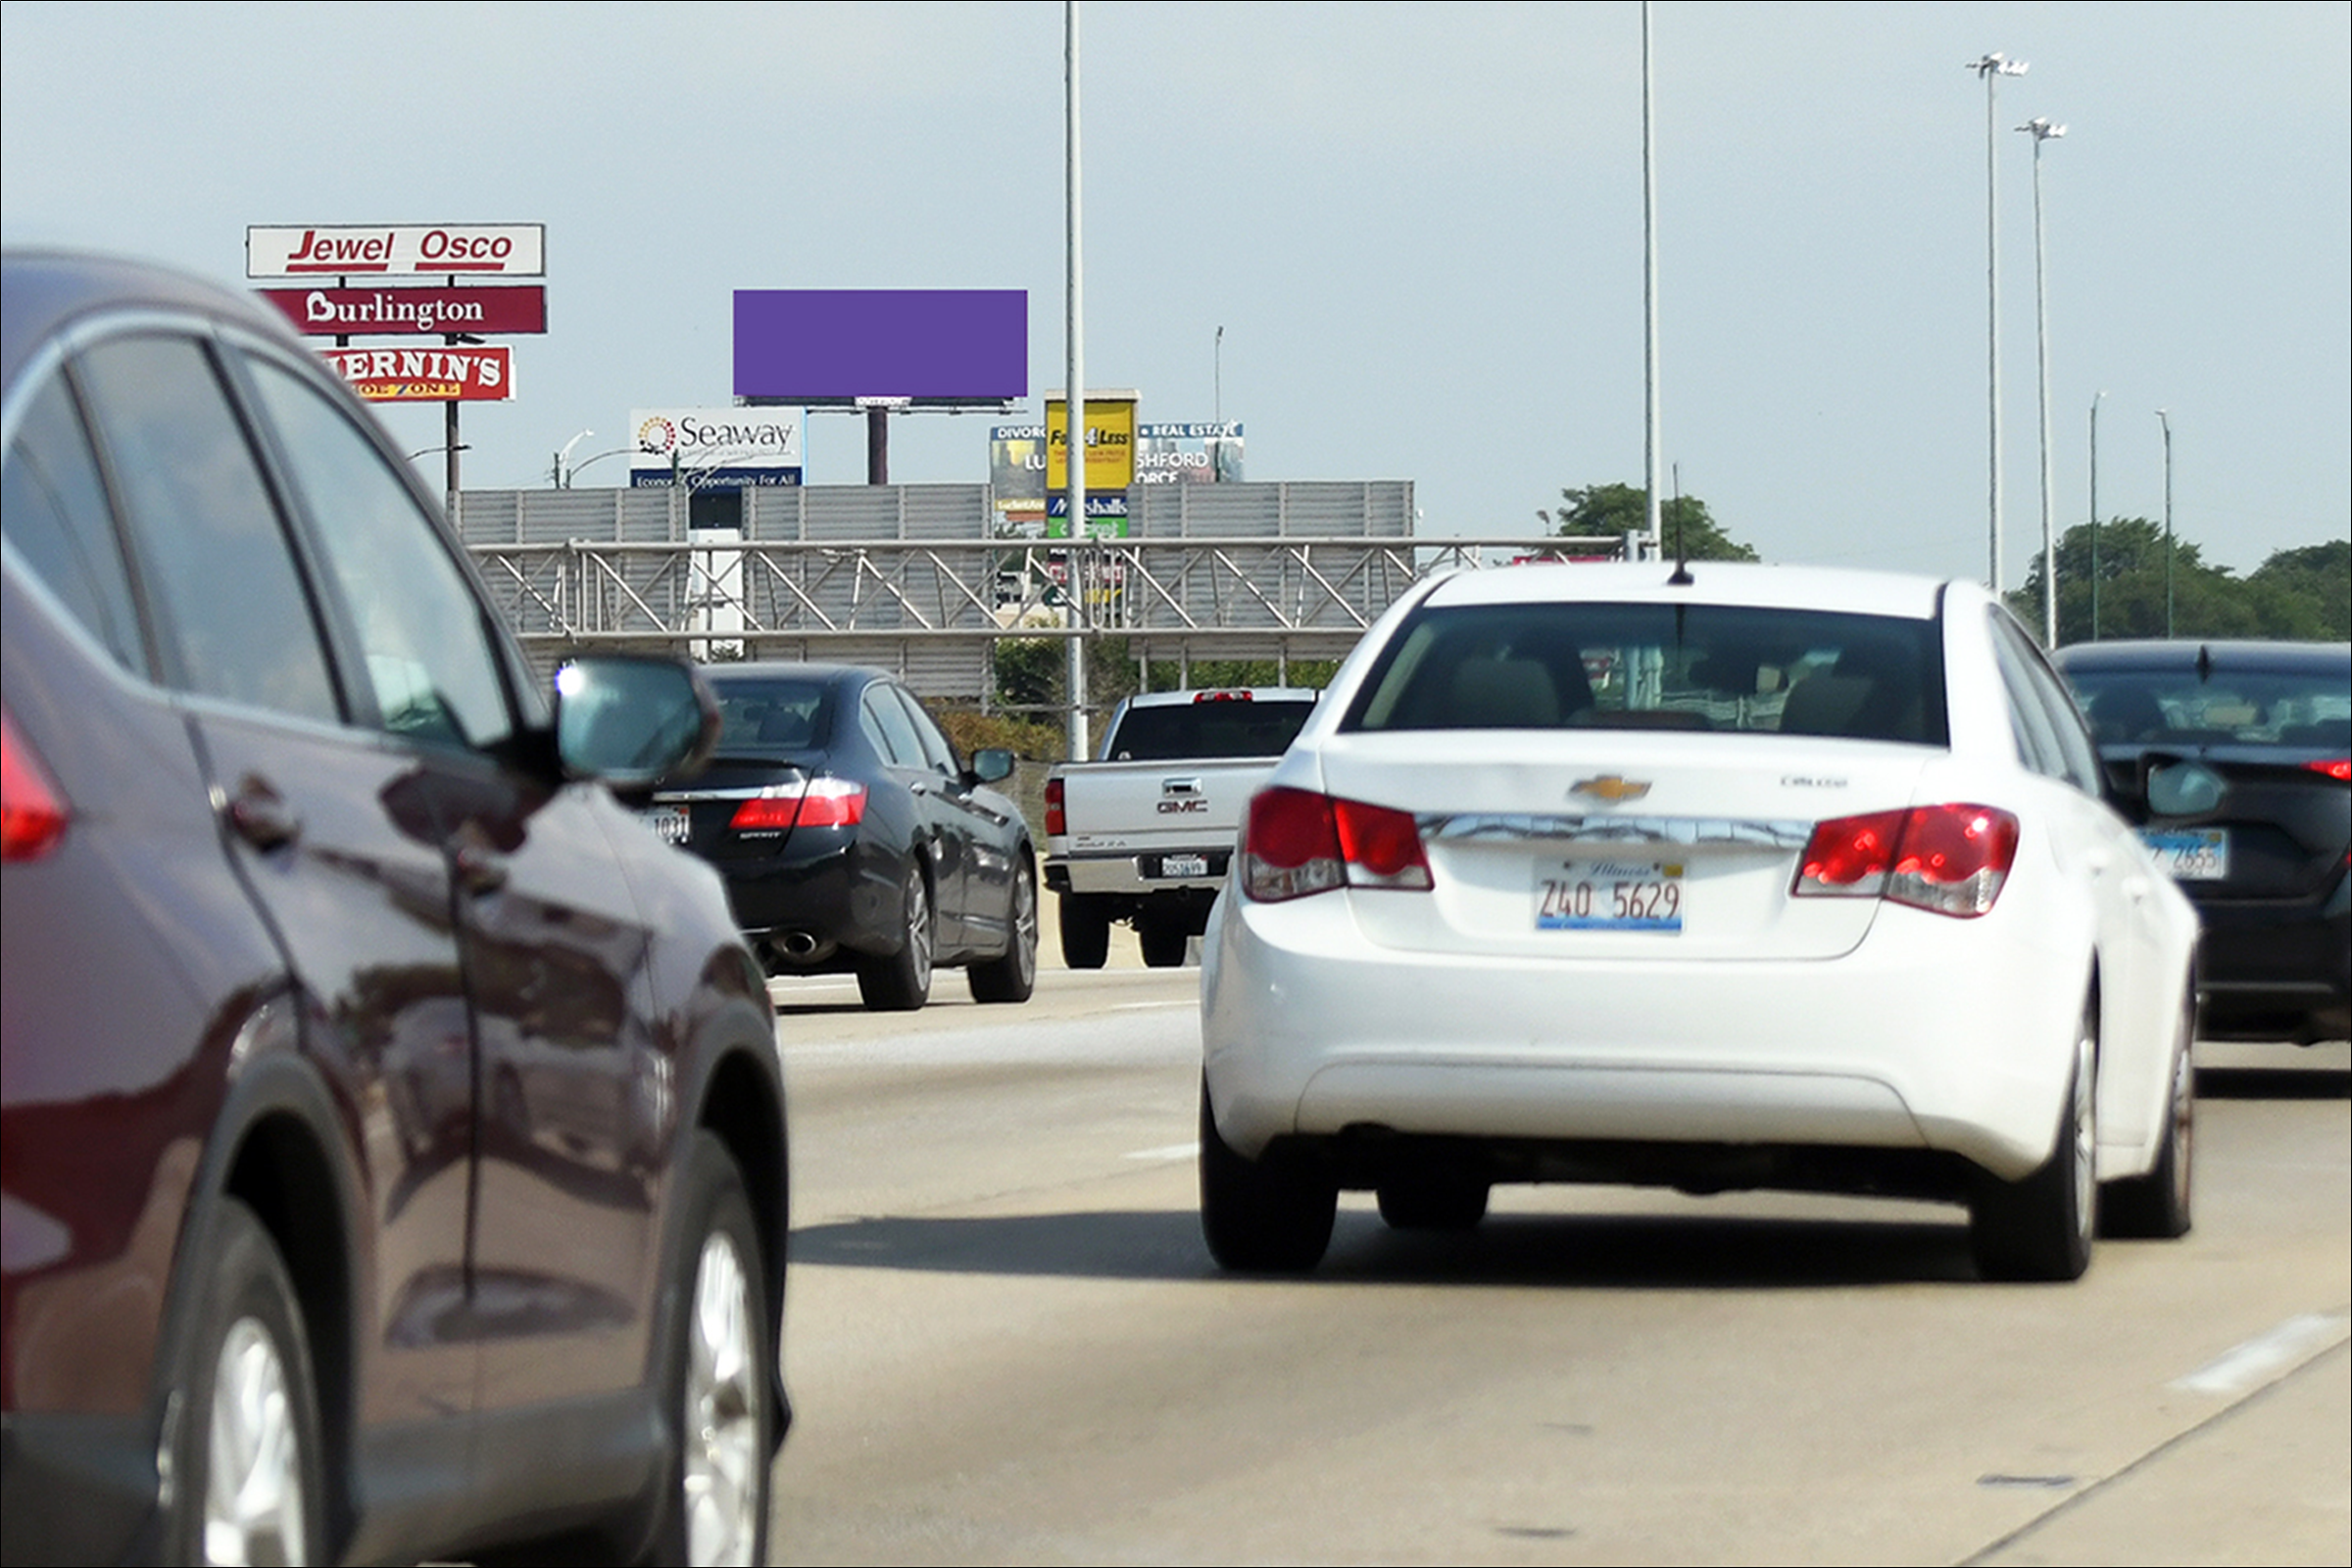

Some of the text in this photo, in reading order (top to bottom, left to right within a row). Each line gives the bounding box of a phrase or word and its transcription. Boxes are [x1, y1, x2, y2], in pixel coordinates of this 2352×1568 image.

[288, 230, 513, 261] Jewel Osco
[307, 291, 484, 331] Burlington
[323, 350, 502, 387] ERNIN'S
[680, 416, 793, 453] Seaway
[1152, 424, 1186, 436] REAL
[1137, 452, 1208, 467] SHFORD
[760, 475, 777, 486] For
[779, 474, 795, 485] All
[1137, 471, 1177, 483] ORCE
[1052, 498, 1127, 515] Mshalls
[1157, 800, 1208, 813] GMC
[1540, 880, 1681, 919] Z40 5629
